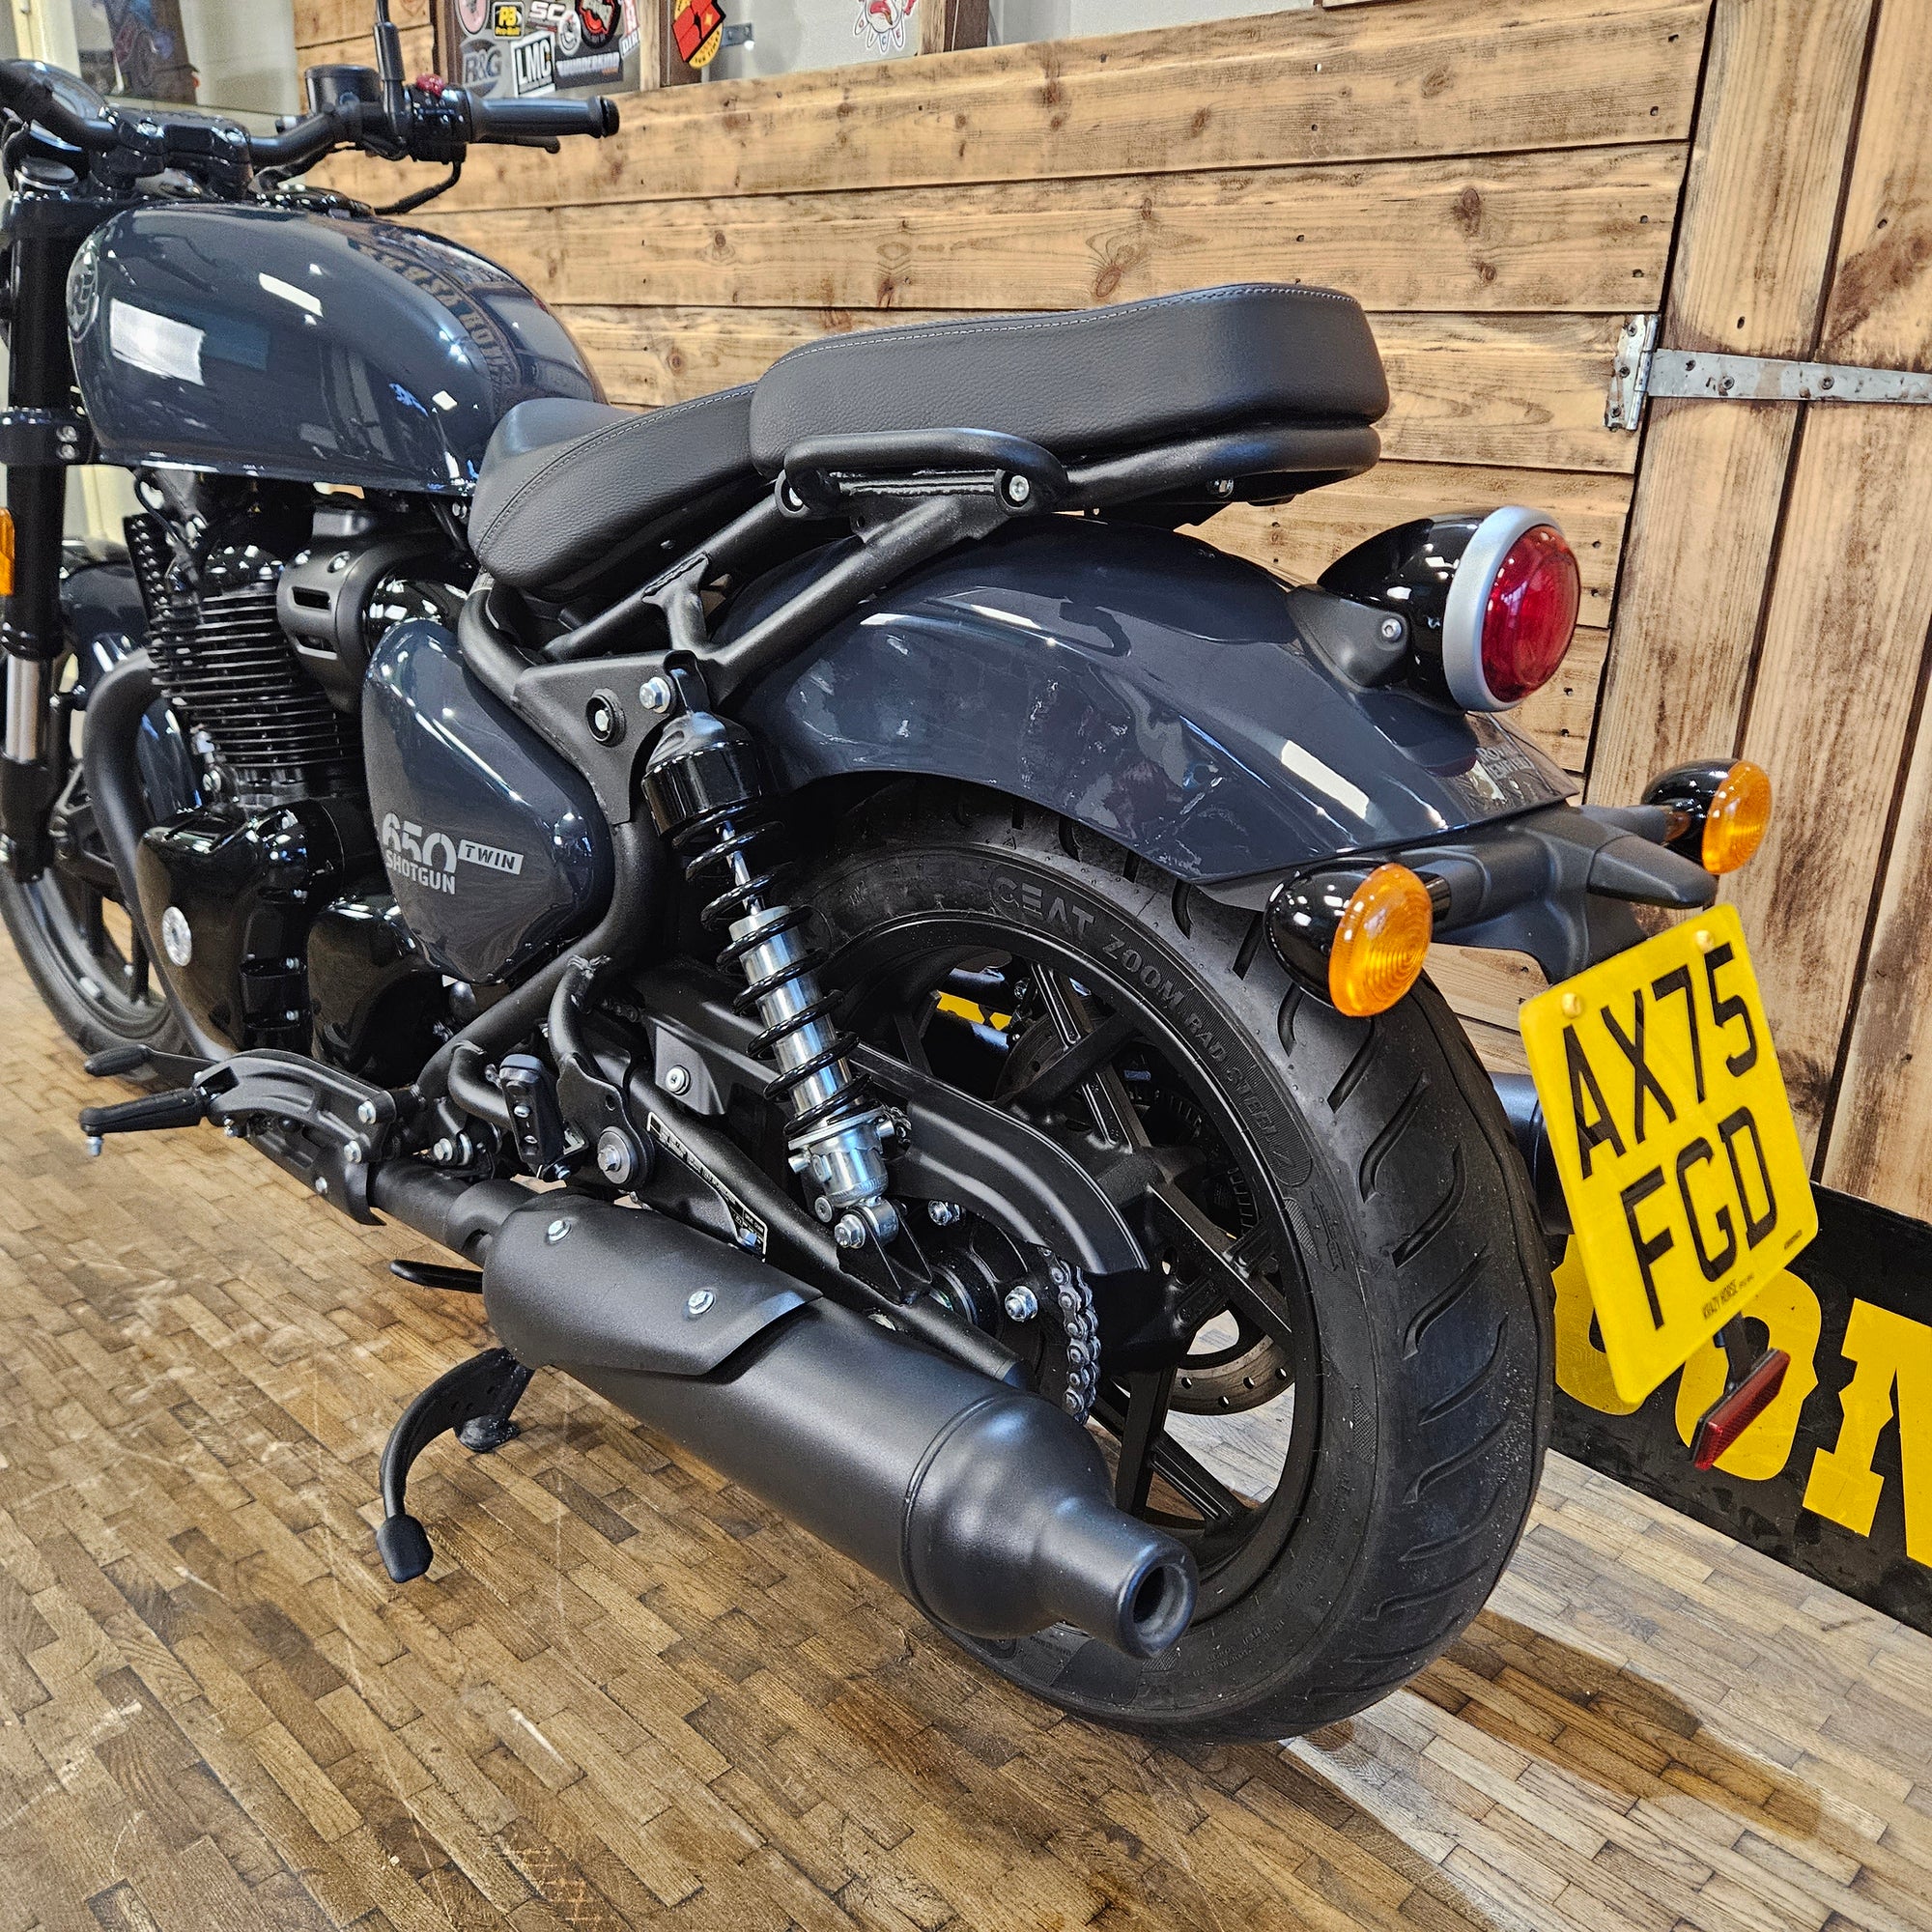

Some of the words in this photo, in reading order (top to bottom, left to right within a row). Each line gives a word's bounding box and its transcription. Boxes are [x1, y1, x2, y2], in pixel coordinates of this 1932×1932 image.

[465, 49, 502, 83] R&G
[516, 39, 552, 85] LMC
[383, 812, 457, 873] 650
[465, 844, 516, 869] TWIN
[386, 849, 455, 895] SHOTGUN
[990, 876, 1095, 941] CEAT
[1102, 934, 1185, 1010] ZOOM
[1184, 1009, 1227, 1063] RAD
[1563, 942, 1757, 1179] AX75
[1620, 1106, 1777, 1330] FGD
